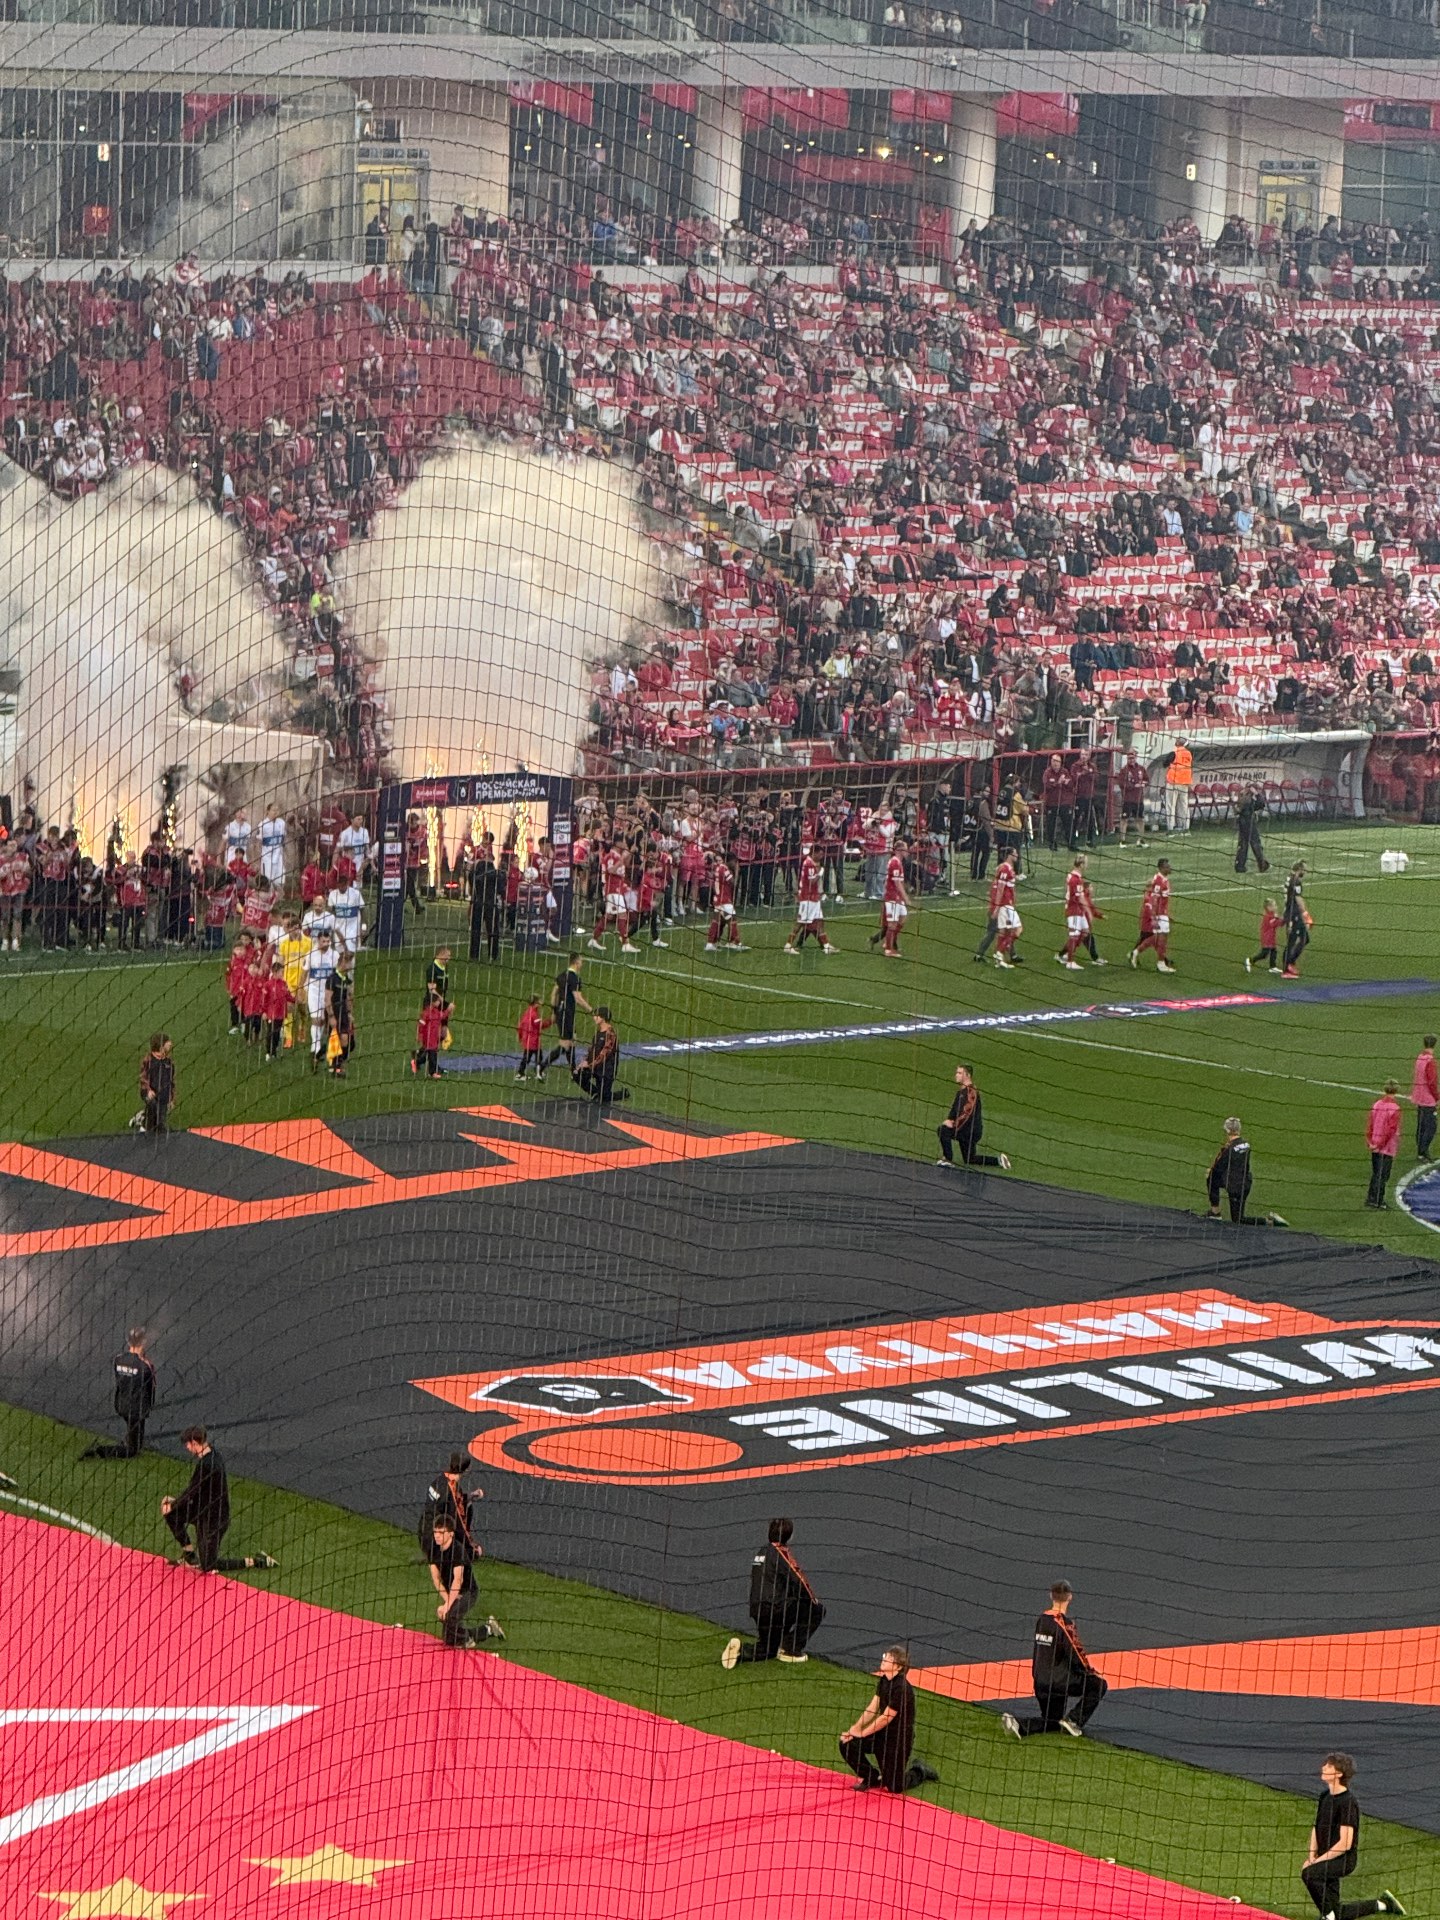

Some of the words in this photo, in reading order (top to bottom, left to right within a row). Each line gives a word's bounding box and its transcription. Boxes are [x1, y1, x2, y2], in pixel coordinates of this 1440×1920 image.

[475, 778, 536, 790] РОССИЙСКАЯ
[475, 787, 546, 799] ПРЕМЬЕР-ЛИГА
[950, 1302, 1272, 1354] МАТЧ
[648, 1340, 972, 1389] ТУРА
[729, 1333, 1440, 1450] WINLINE
